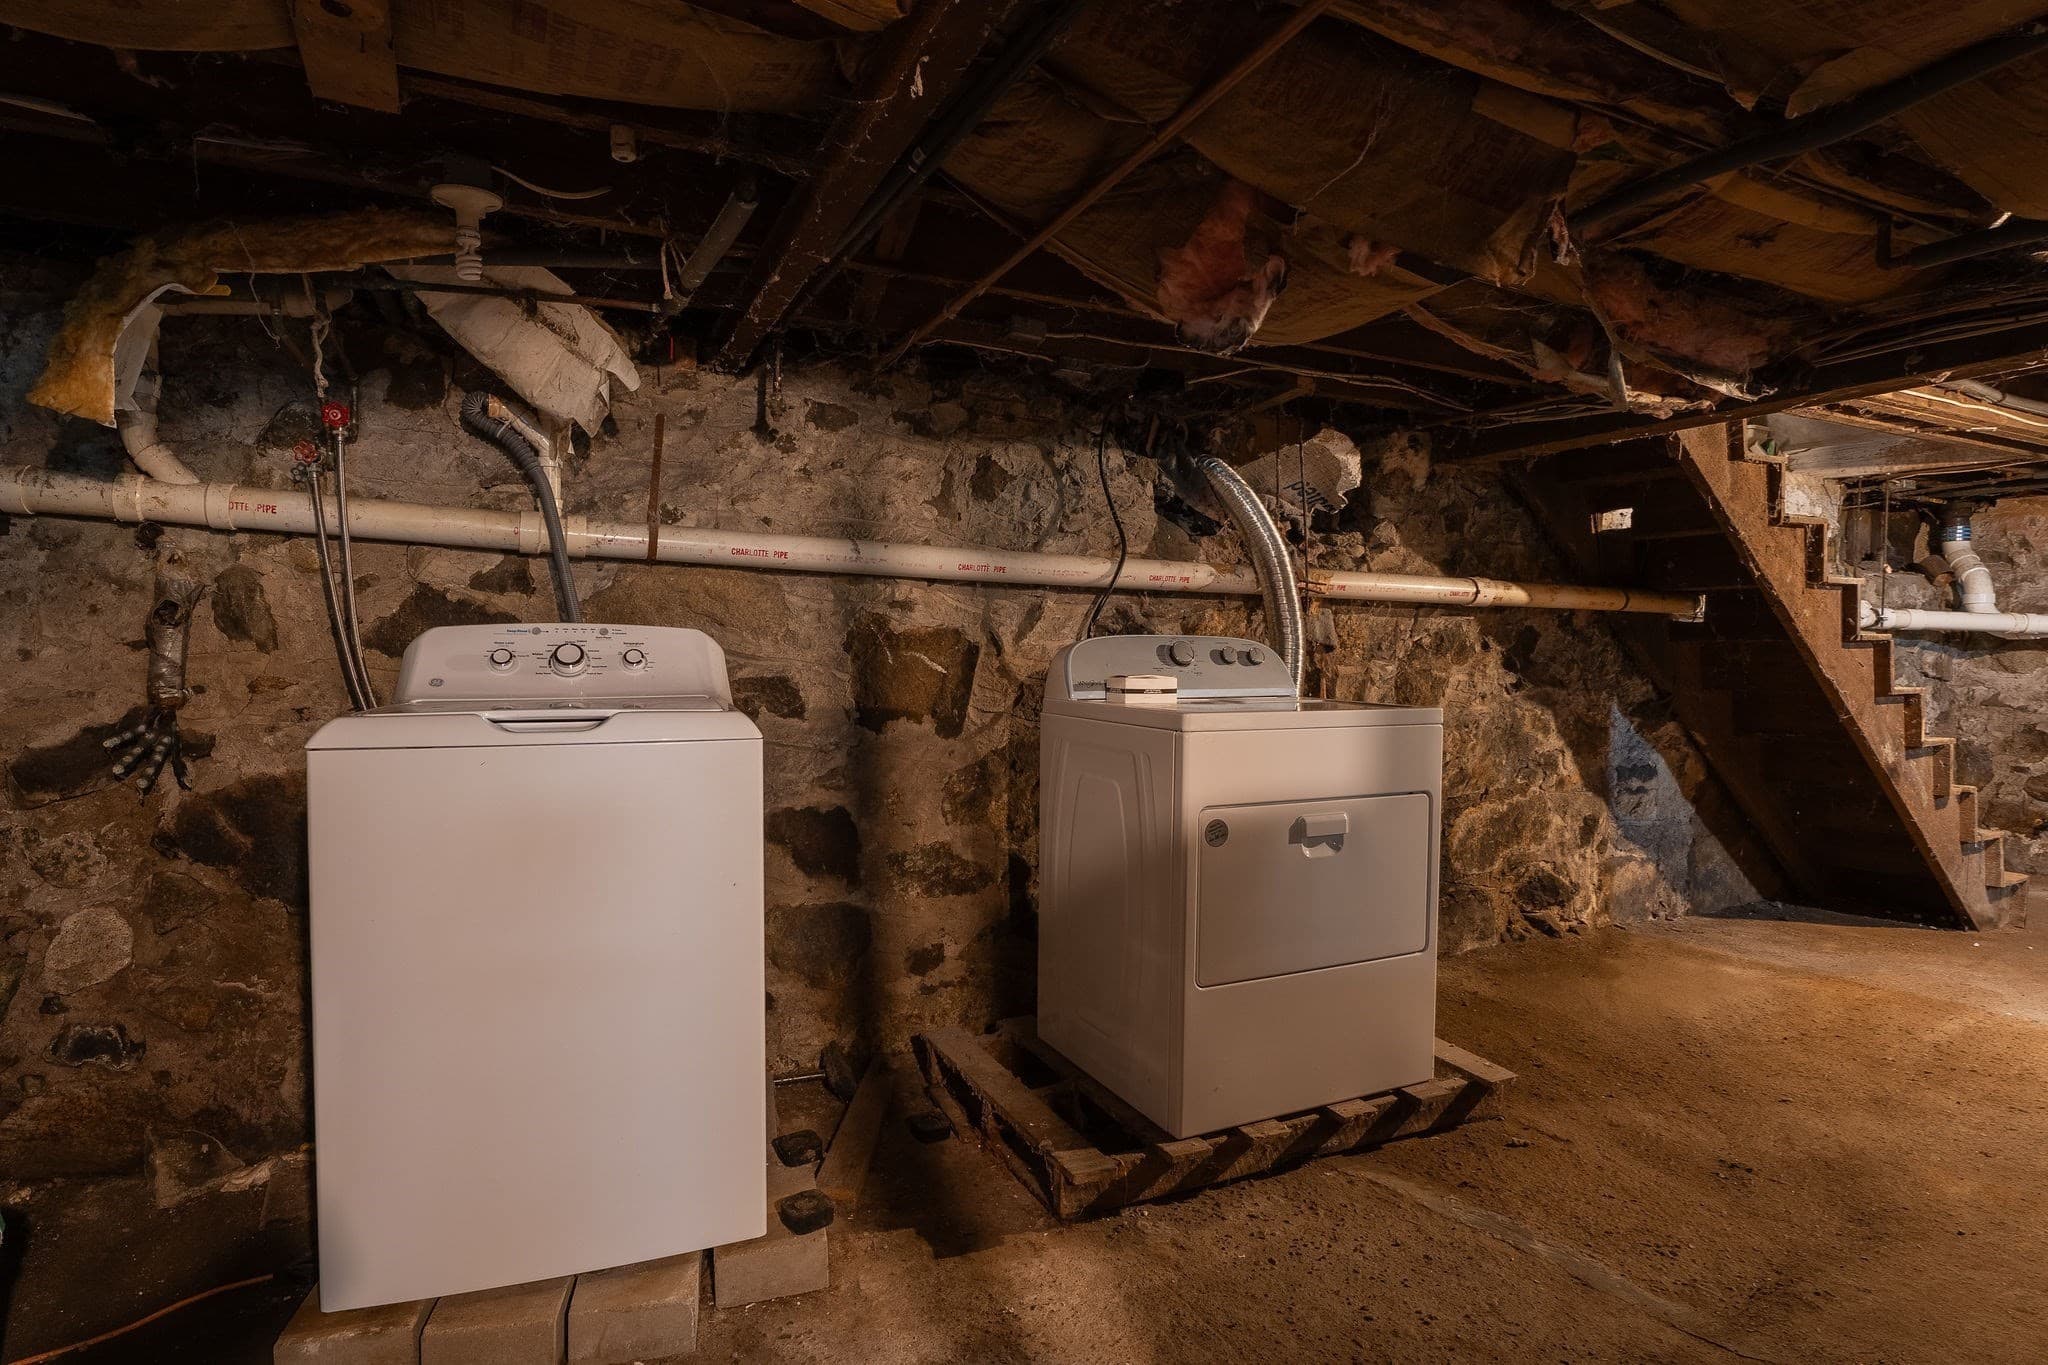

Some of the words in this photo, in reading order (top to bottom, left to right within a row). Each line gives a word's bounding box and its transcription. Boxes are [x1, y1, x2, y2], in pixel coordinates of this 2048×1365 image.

[256, 503, 277, 514] PIPE
[731, 547, 769, 558] CHARLOTTE
[773, 550, 789, 560] PIPE
[957, 563, 991, 573] CHARLOTTE
[993, 565, 1008, 574] PIPE
[1148, 574, 1177, 583] CHARLOTTE
